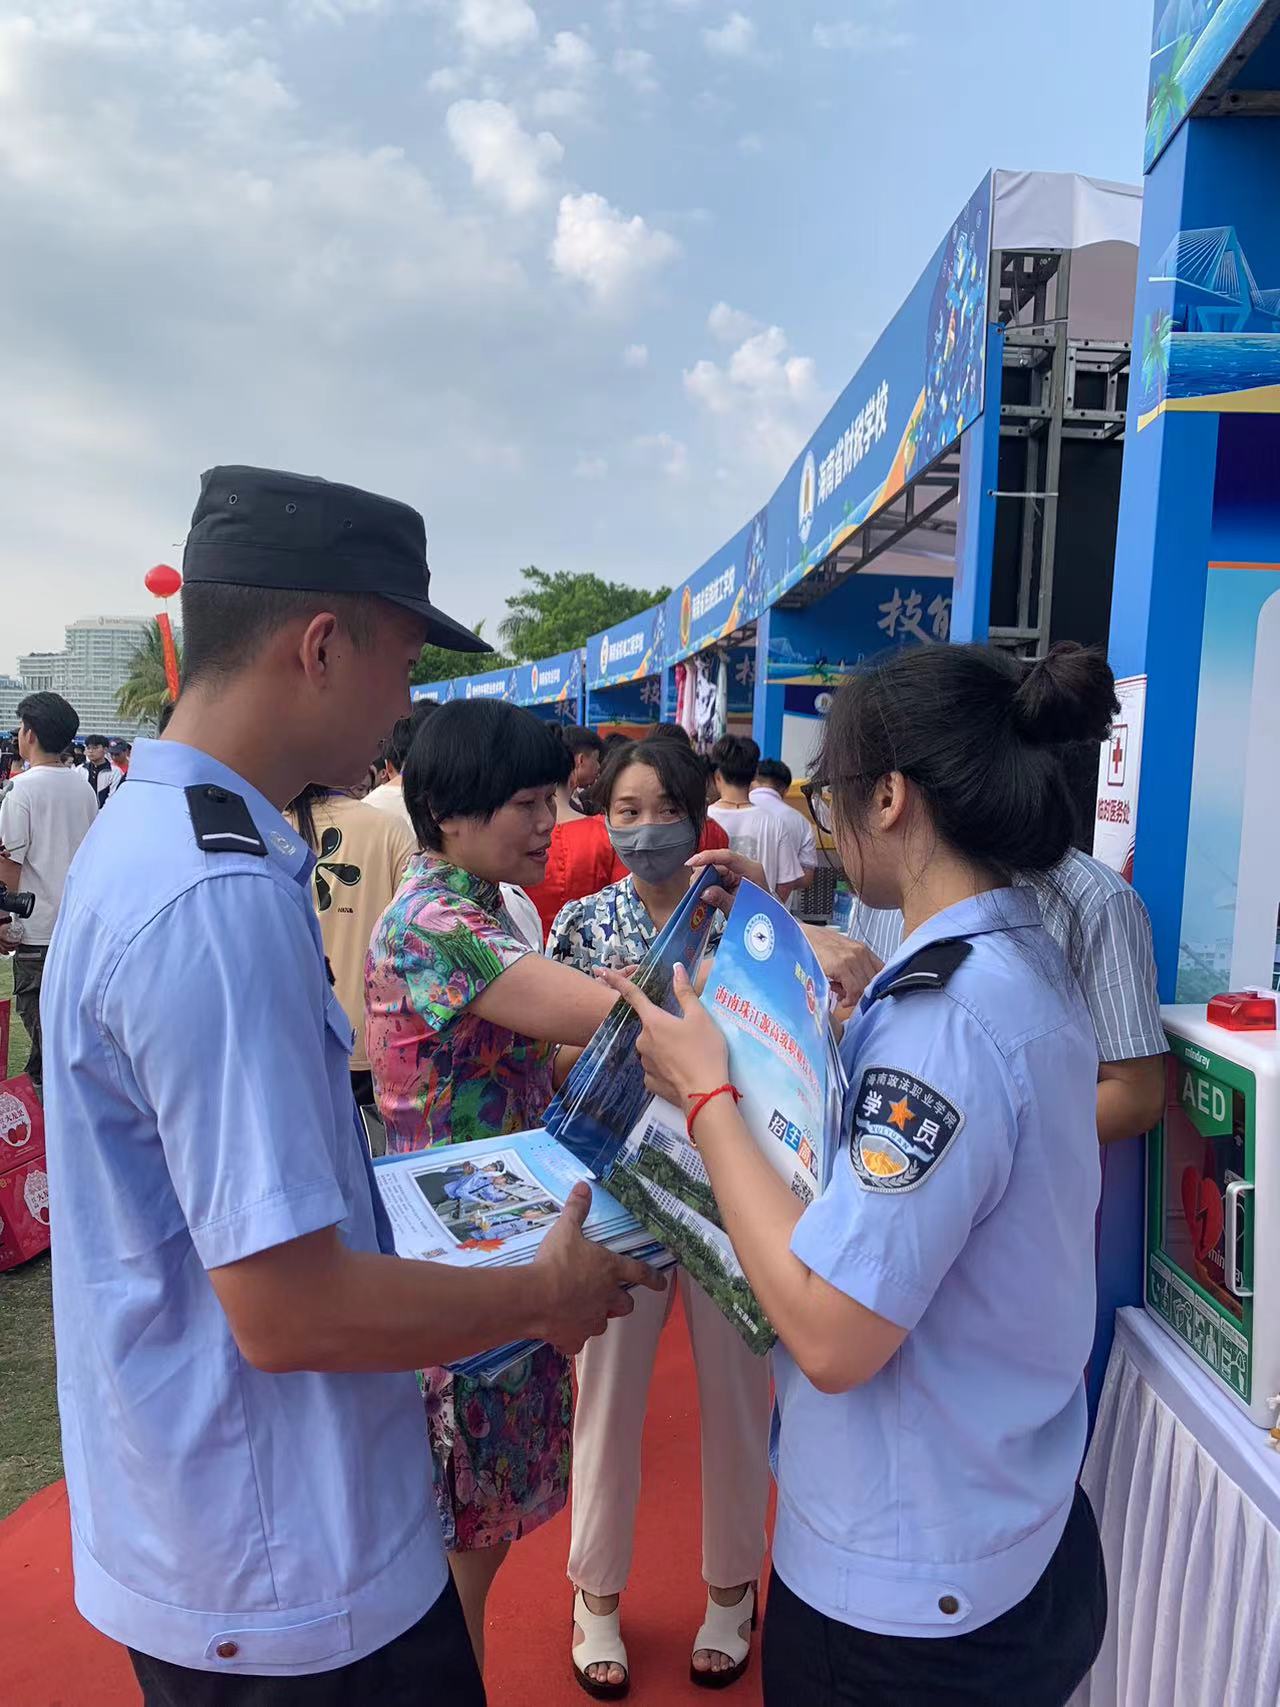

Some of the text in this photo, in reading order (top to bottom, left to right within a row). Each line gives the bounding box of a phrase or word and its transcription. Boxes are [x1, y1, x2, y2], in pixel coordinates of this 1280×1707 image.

[818, 379, 889, 506] 海南省财税学校
[1097, 799, 1130, 825] 临时医务处
[1184, 1047, 1211, 1071] mindray
[861, 1089, 941, 1151] 学 员
[865, 1072, 958, 1131] 海南政法职业学院
[1182, 1072, 1226, 1123] AED
